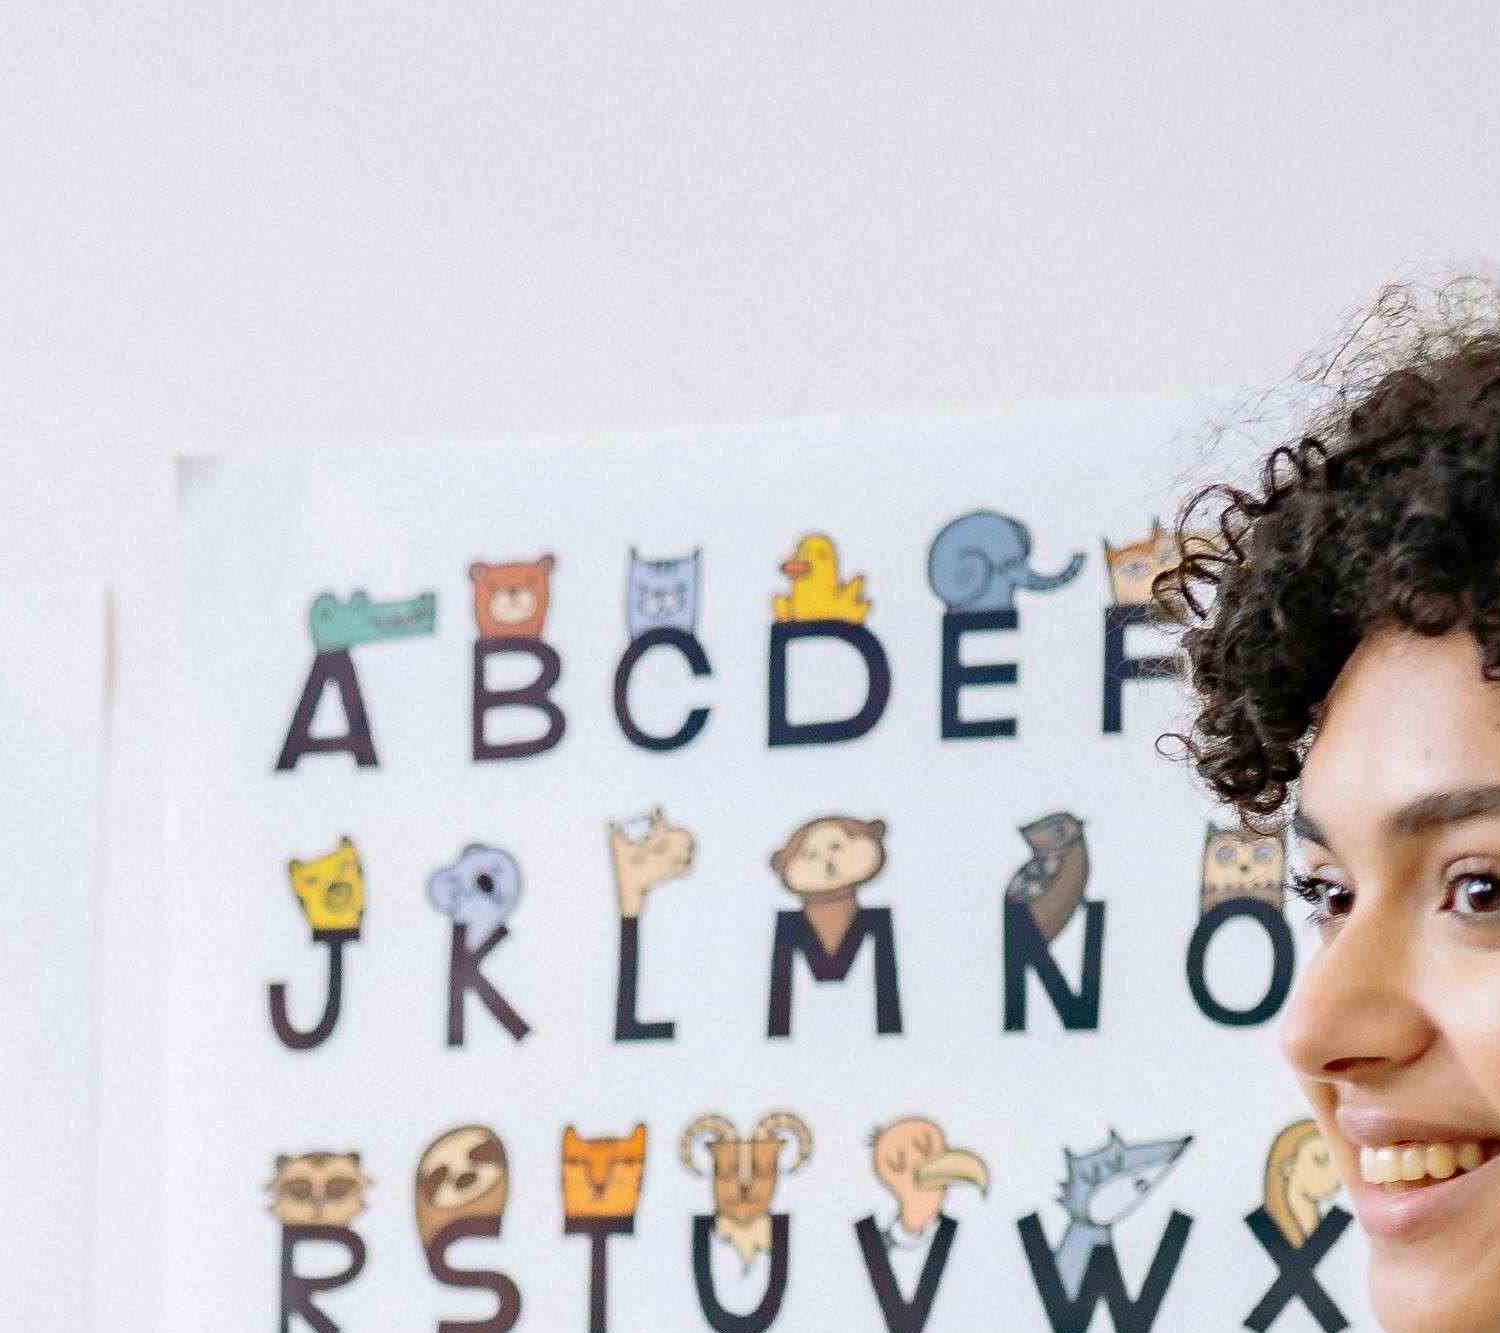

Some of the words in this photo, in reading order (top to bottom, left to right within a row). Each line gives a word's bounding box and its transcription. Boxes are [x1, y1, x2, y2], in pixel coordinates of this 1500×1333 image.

[274, 648, 380, 772] A
[471, 635, 568, 762] B
[612, 626, 713, 752] C
[766, 618, 894, 748] D
[940, 608, 1019, 739] E
[1101, 603, 1188, 734] F
[268, 926, 362, 1050] J
[446, 922, 532, 1047] K
[612, 915, 677, 1042] L
[766, 904, 904, 1039] M
[1002, 898, 1106, 1032] N
[1186, 895, 1295, 1027] O
